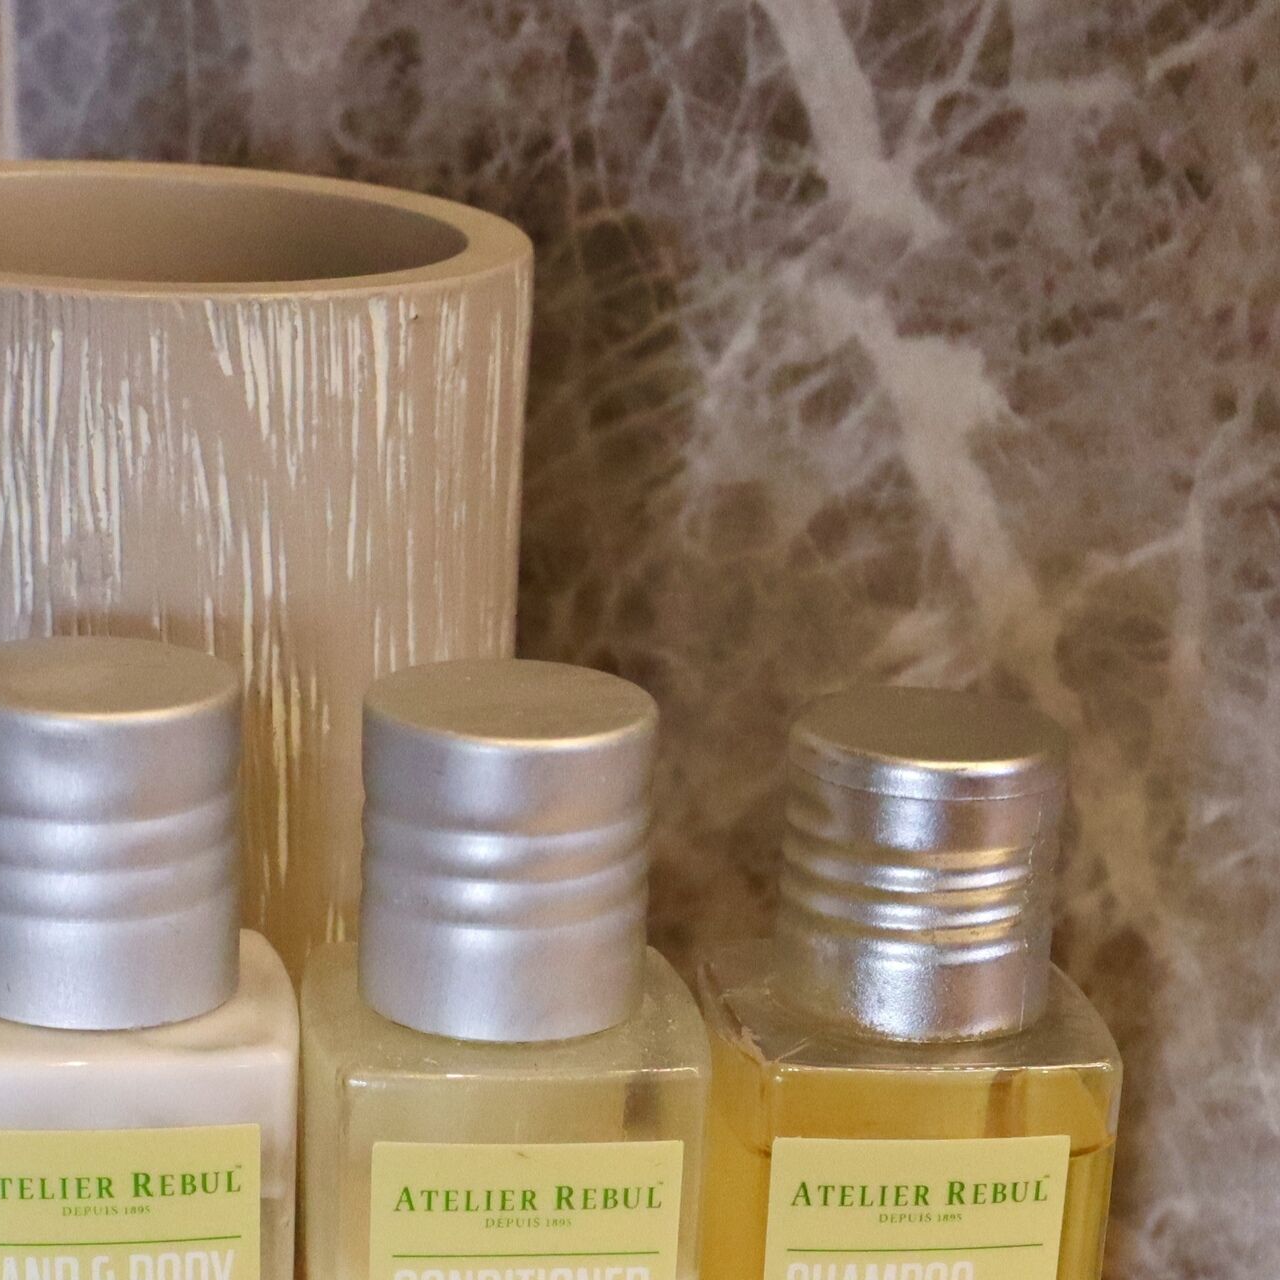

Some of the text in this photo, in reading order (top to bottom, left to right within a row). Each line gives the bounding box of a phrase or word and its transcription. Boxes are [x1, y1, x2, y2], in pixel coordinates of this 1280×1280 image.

[393, 1186, 538, 1213] ATELIER
[790, 1181, 930, 1208] ATELIER
[62, 1205, 151, 1217] DEPUIS 1895
[485, 1217, 540, 1229] DEPUIS
[879, 1212, 963, 1224] DEPUIS 1895
